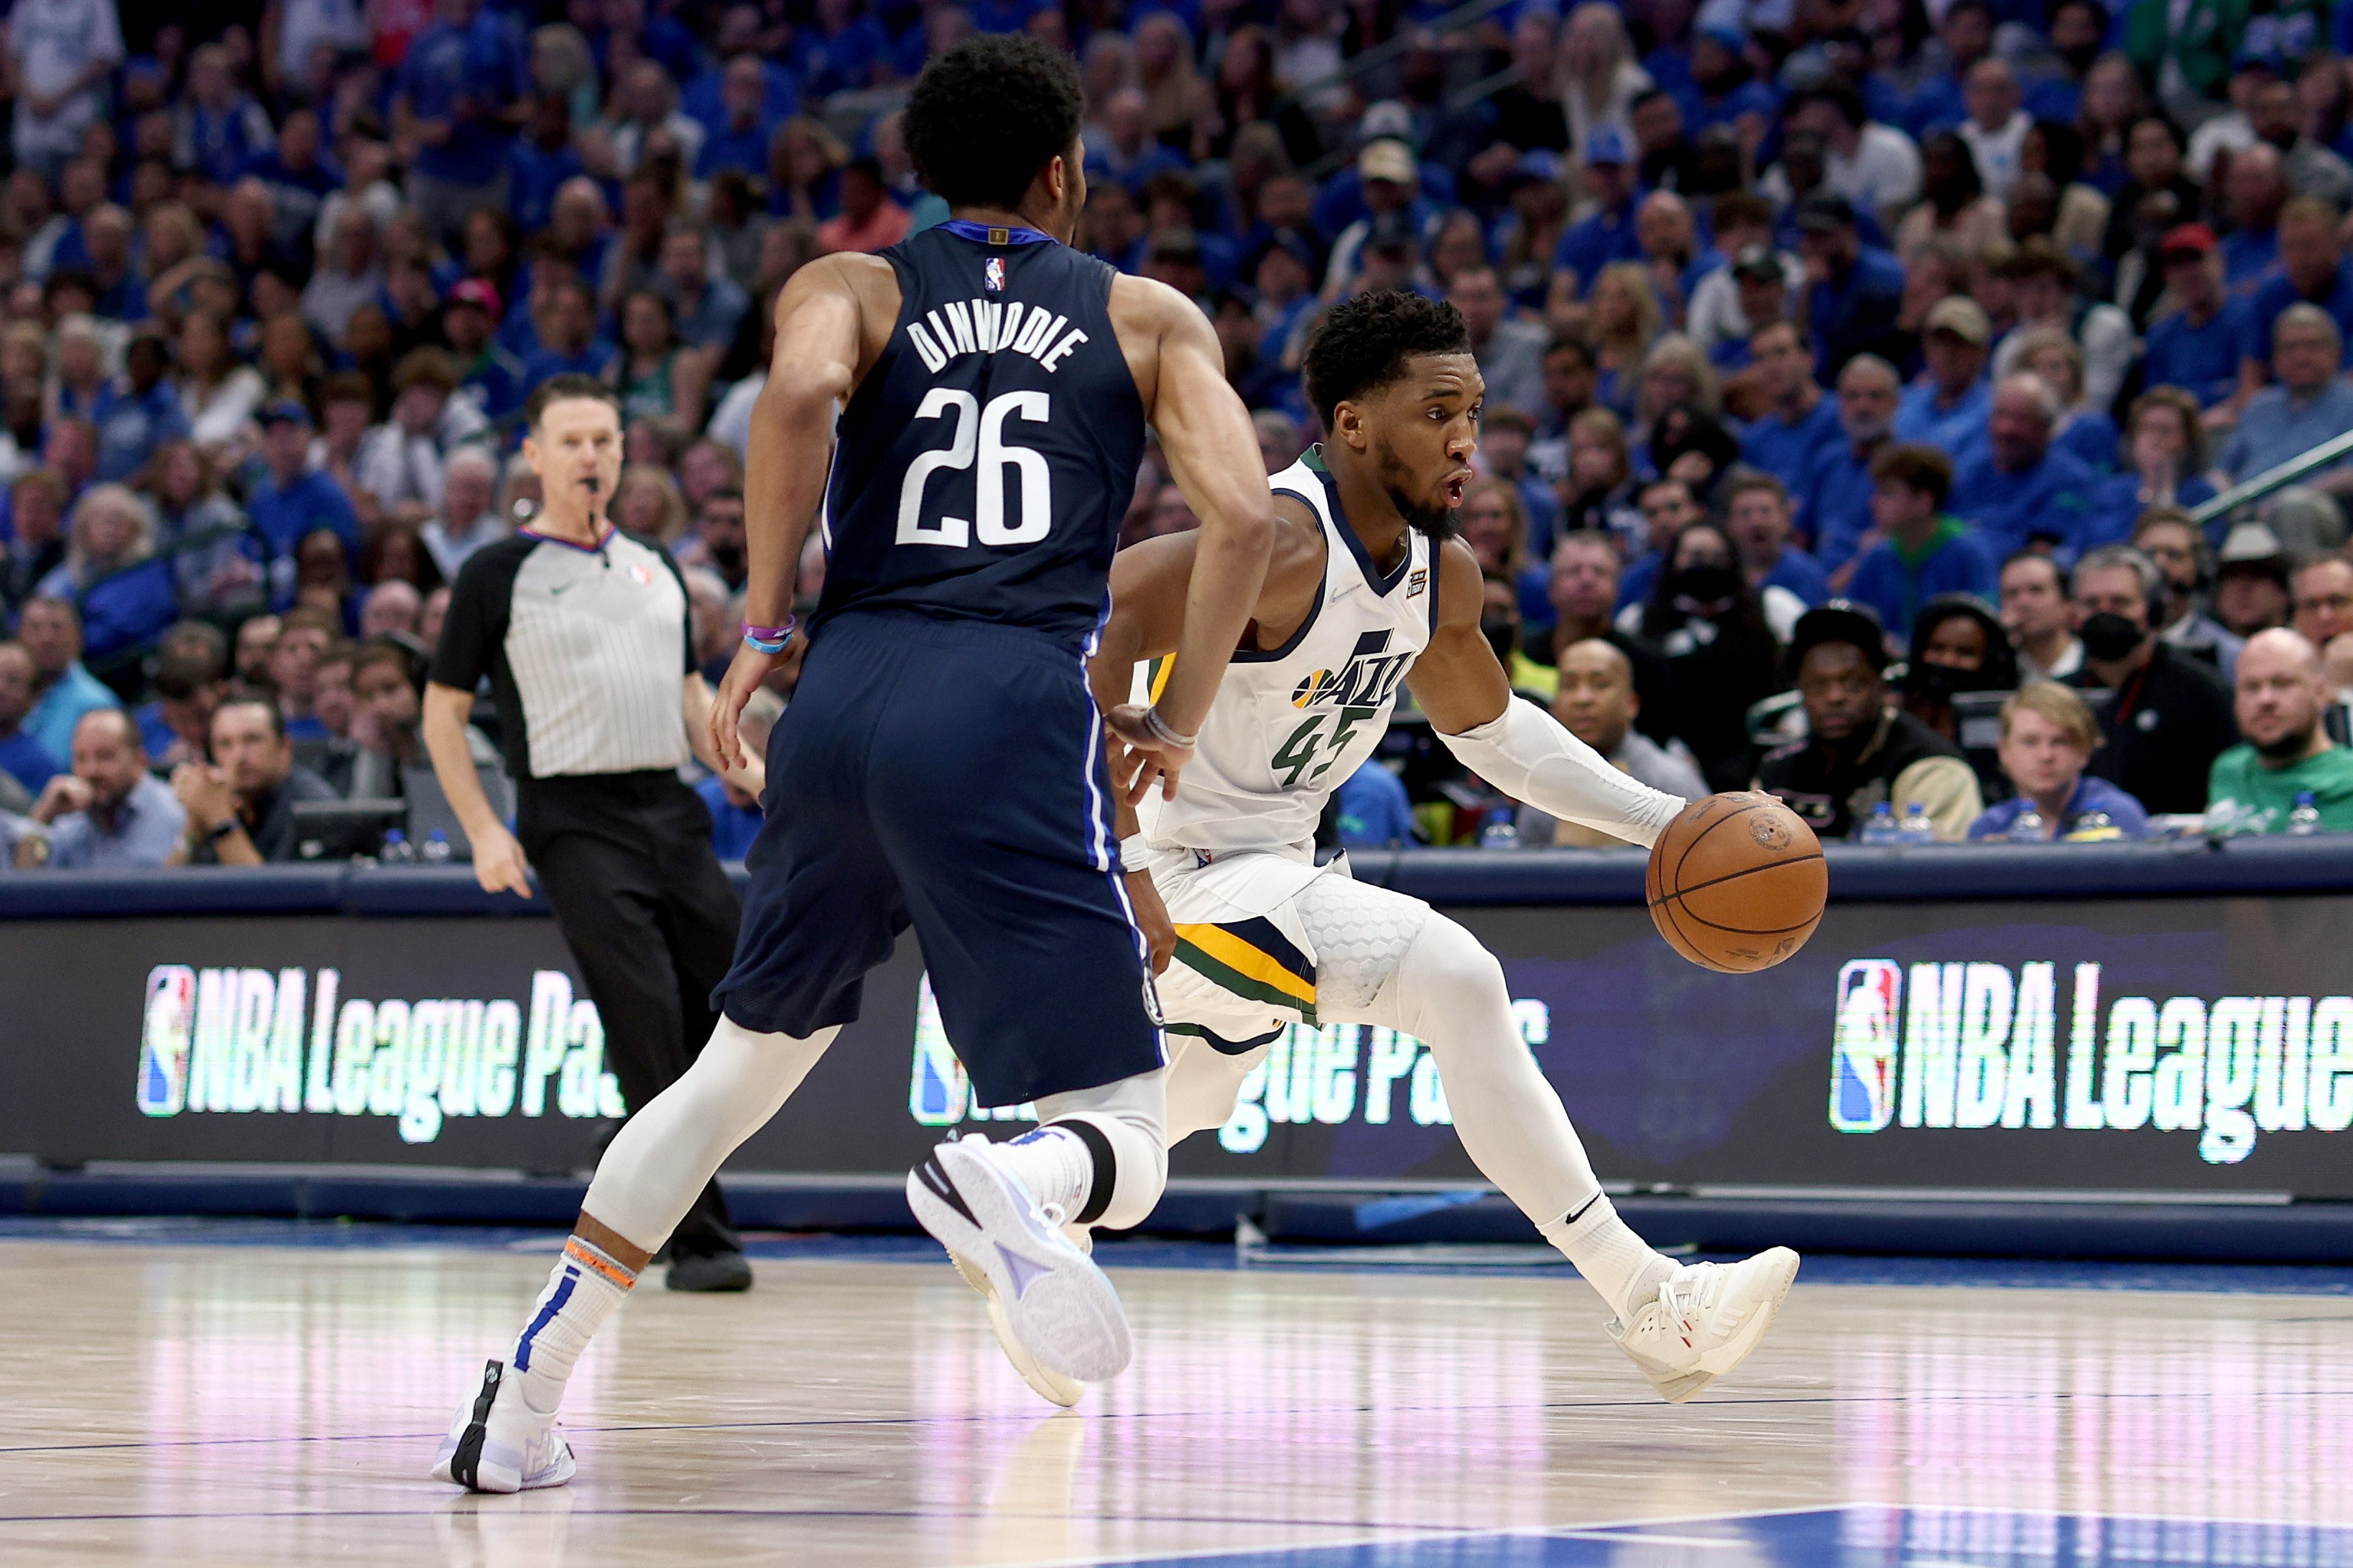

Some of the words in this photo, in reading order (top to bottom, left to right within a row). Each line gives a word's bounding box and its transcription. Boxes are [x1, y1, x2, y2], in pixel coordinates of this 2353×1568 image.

[894, 387, 1052, 548] 26
[1271, 707, 1377, 787] 45
[185, 966, 308, 1114] NBA
[305, 967, 522, 1144] League
[520, 970, 627, 1118] Pa
[1899, 960, 2056, 1130] NBA
[2063, 960, 2353, 1164] League
